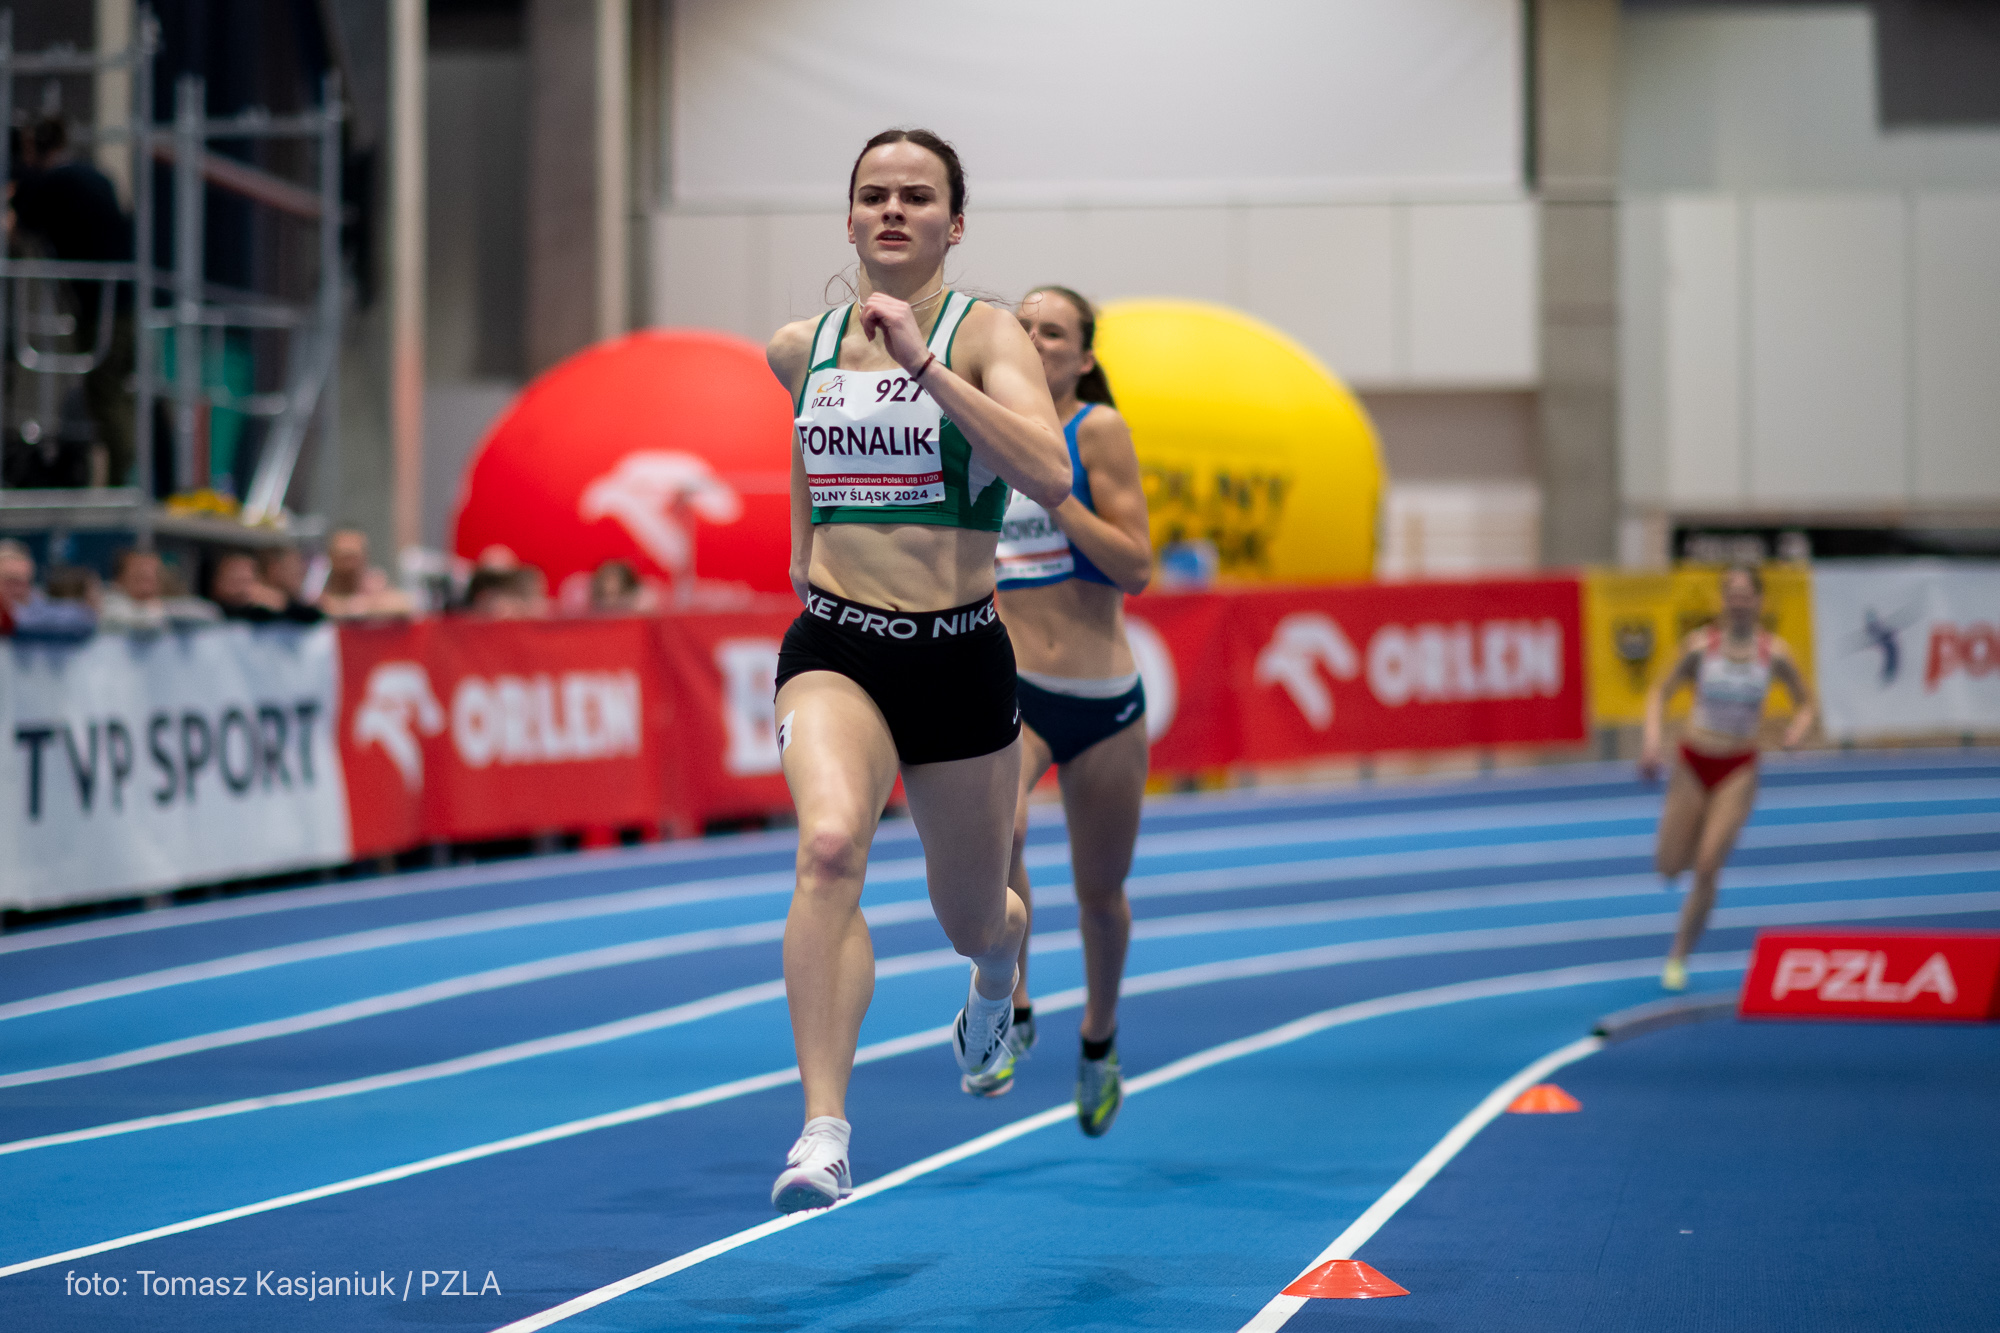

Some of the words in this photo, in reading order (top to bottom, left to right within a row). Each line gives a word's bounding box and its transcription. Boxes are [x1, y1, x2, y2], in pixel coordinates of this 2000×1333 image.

[875, 376, 923, 402] 927
[798, 426, 935, 456] FORNALIK
[812, 491, 847, 502] OLNY
[850, 488, 891, 503] ŚLĄSK
[894, 489, 928, 501] 2024
[838, 476, 881, 484] Mistrzostwa
[883, 476, 904, 484] Polski
[905, 476, 918, 484] U18
[924, 474, 939, 482] U20
[806, 590, 838, 621] KE
[838, 605, 918, 639] PRO
[932, 598, 996, 638] NIKE
[1367, 618, 1565, 706] ORLEN
[453, 670, 642, 768] ORLEN
[16, 718, 133, 823] TVP
[149, 702, 319, 804] SPORT
[1771, 948, 1958, 1004] PZLA
